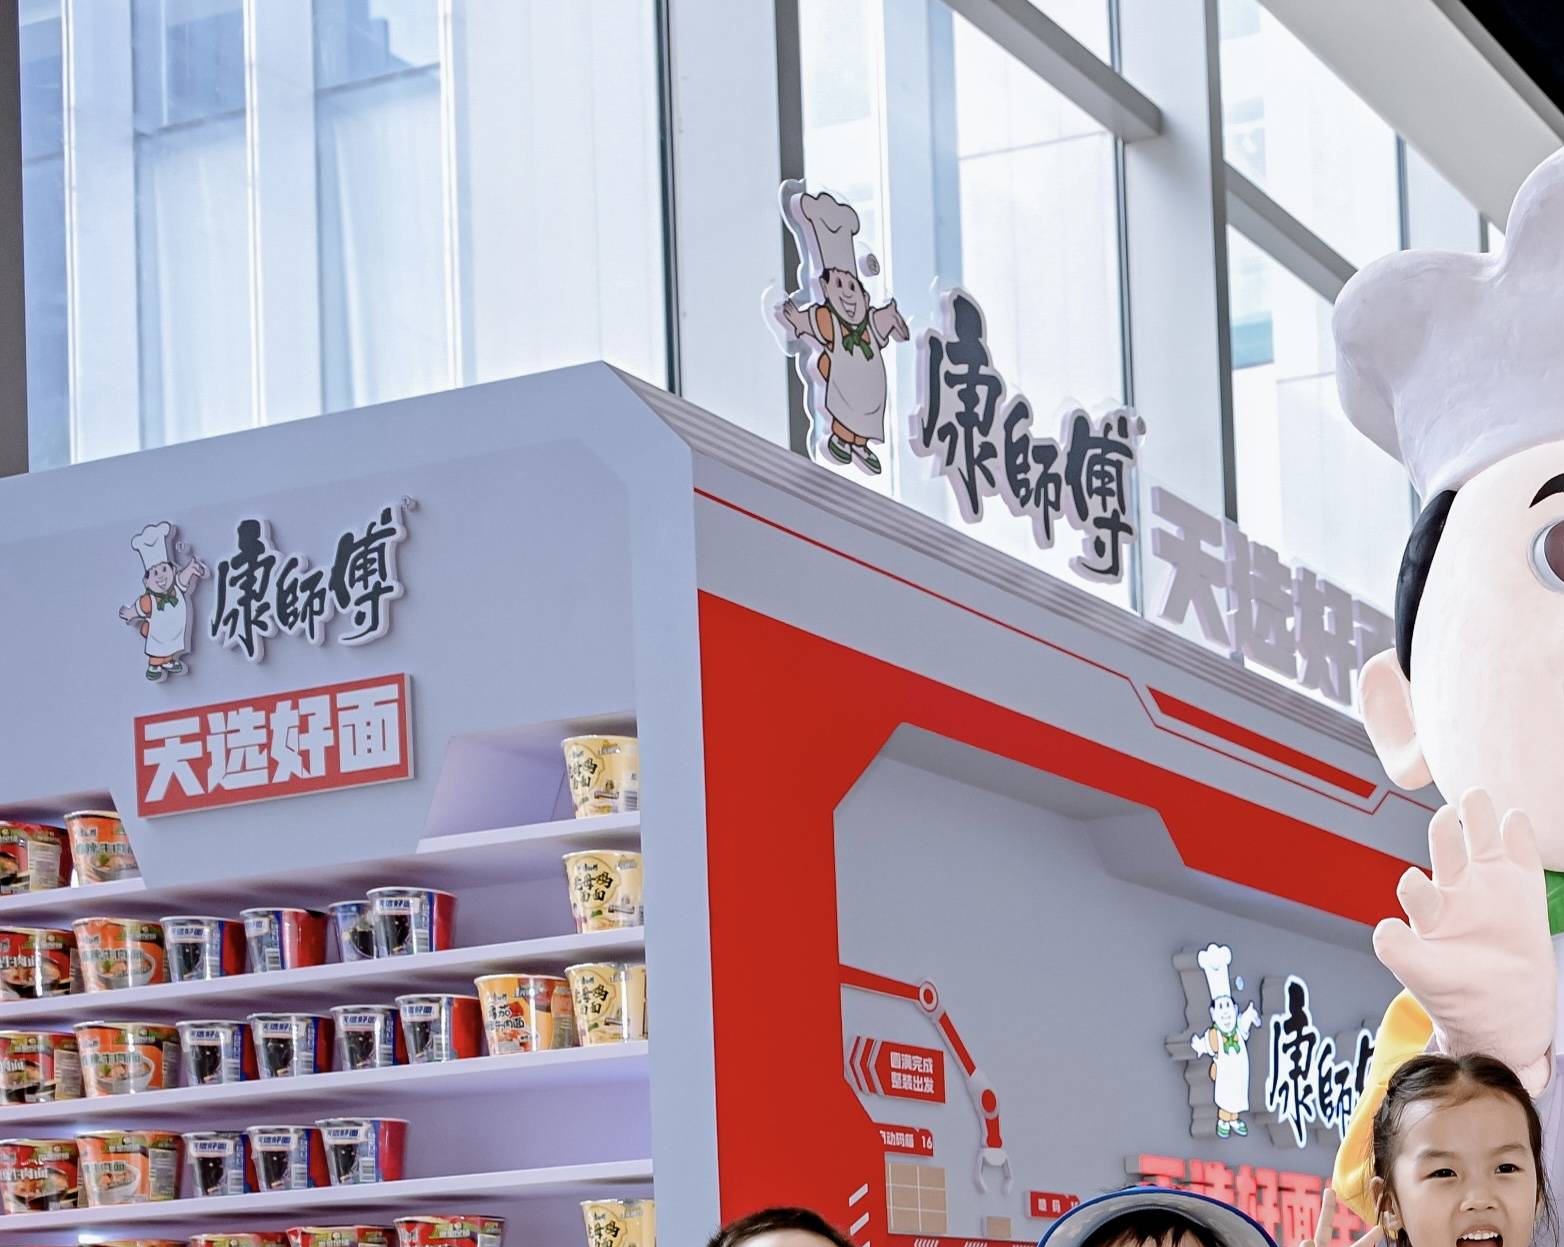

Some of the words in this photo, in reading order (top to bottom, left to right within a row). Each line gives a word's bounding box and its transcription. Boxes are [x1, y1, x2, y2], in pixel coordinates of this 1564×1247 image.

[922, 296, 1132, 576] 康師傅
[211, 507, 396, 657] 康師傅
[144, 684, 399, 802] 天选好面
[921, 1135, 933, 1150] 16
